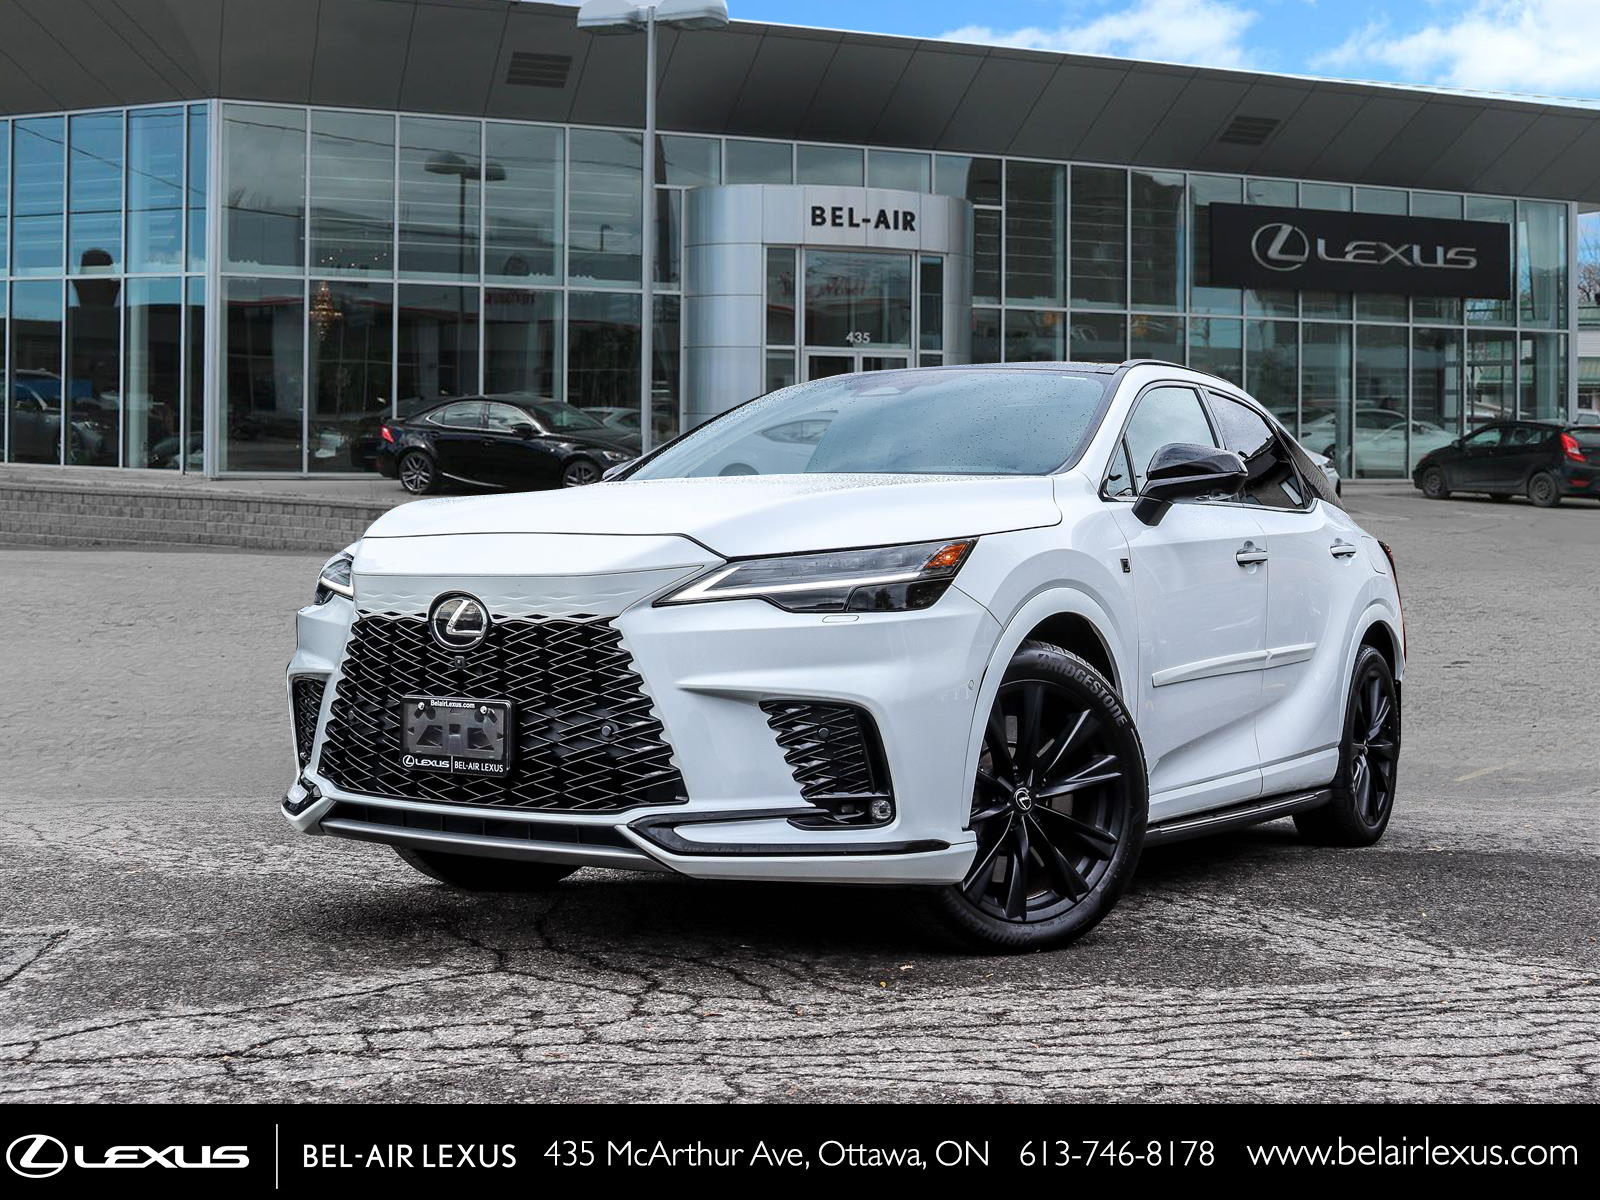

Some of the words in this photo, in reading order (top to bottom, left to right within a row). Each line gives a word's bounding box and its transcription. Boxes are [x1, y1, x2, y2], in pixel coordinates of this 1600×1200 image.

[810, 205, 917, 232] BEL-AIR
[1316, 237, 1478, 269] LEXUS
[846, 331, 871, 344] 435
[430, 700, 475, 709] BelairLexus.com
[415, 759, 449, 768] LEXUS
[481, 763, 504, 773] LEXUS
